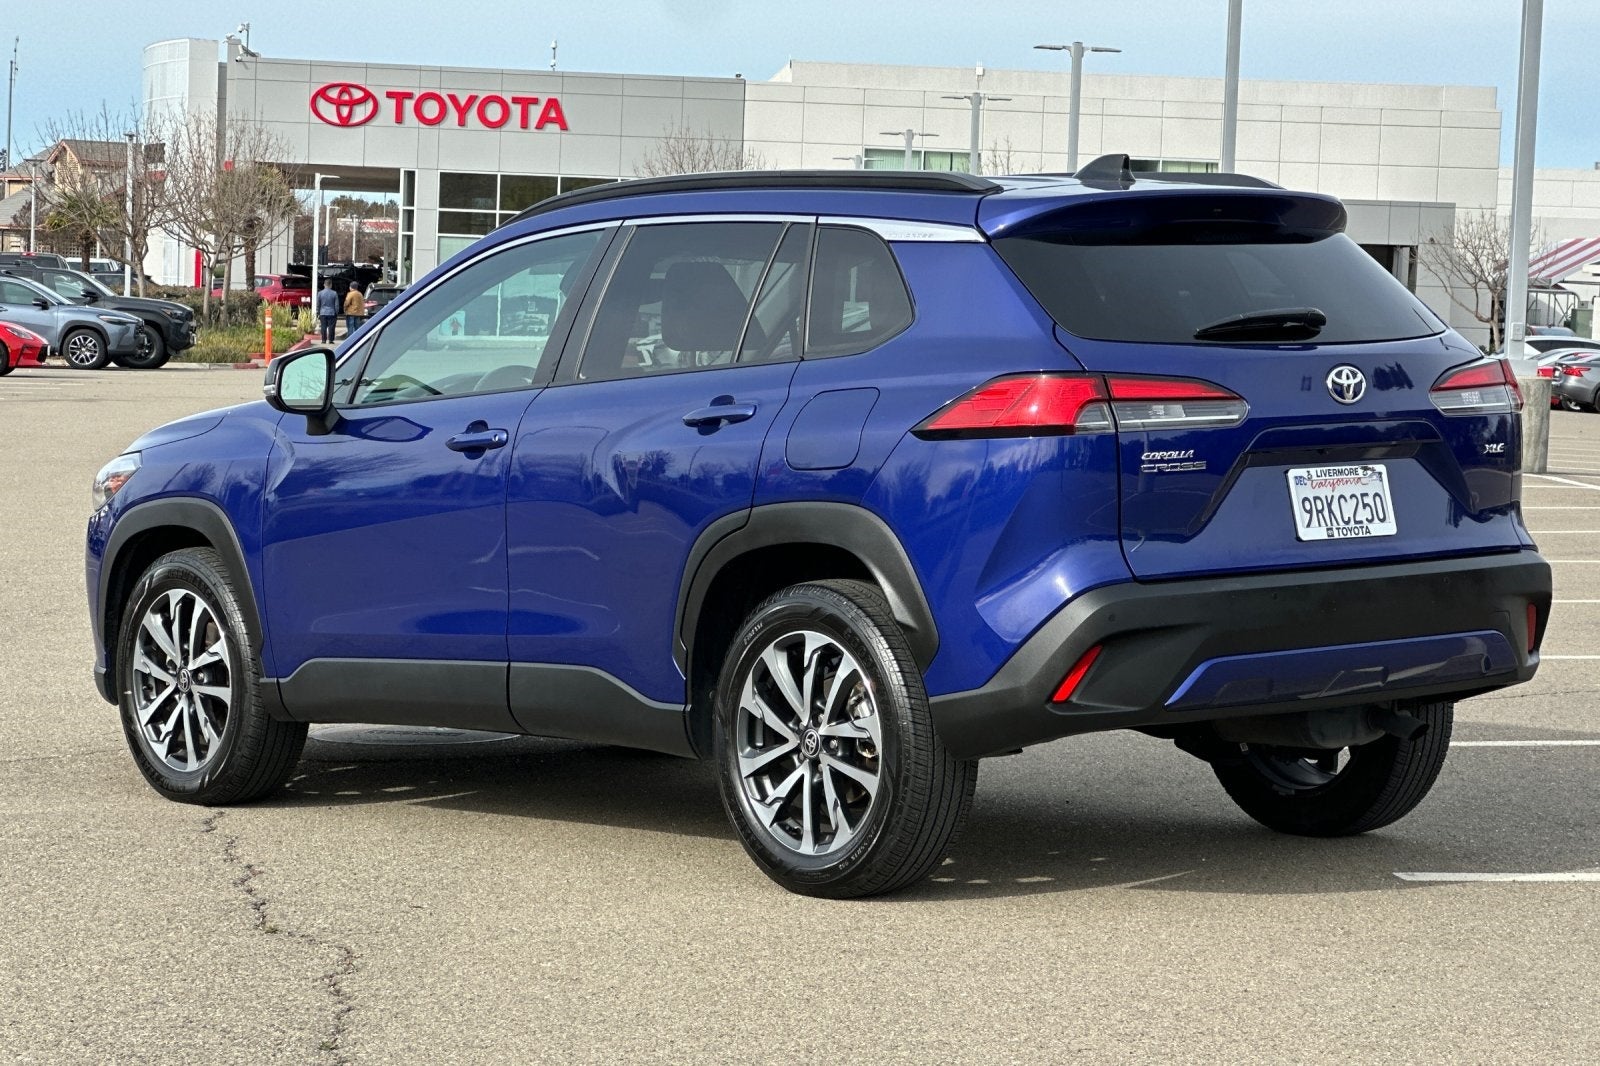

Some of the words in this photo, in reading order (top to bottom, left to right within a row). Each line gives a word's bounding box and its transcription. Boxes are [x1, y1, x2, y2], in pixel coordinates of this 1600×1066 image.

[386, 91, 568, 130] TOYOTA
[1483, 443, 1505, 454] XLE
[1141, 450, 1194, 460] COROLLA
[1141, 461, 1207, 472] CROSS
[1316, 467, 1359, 478] LIVERMORE
[1302, 492, 1387, 528] 9RKC250
[1336, 526, 1371, 537] TOYOTA
